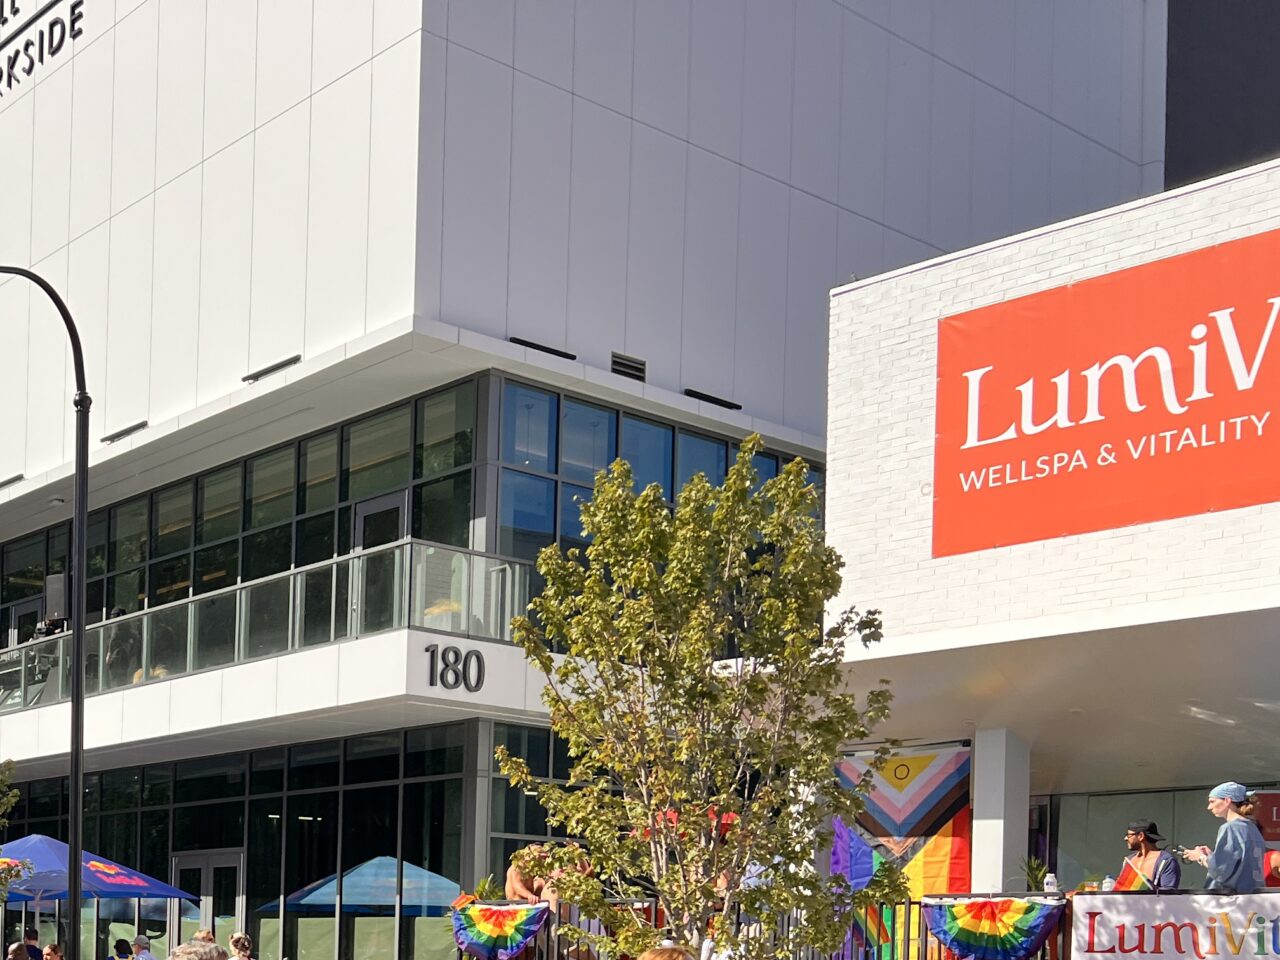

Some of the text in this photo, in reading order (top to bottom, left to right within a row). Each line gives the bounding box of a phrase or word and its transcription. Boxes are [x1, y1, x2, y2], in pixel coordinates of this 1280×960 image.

[959, 411, 1271, 492] WELLSPA & VITALITY
[424, 643, 486, 693] 180
